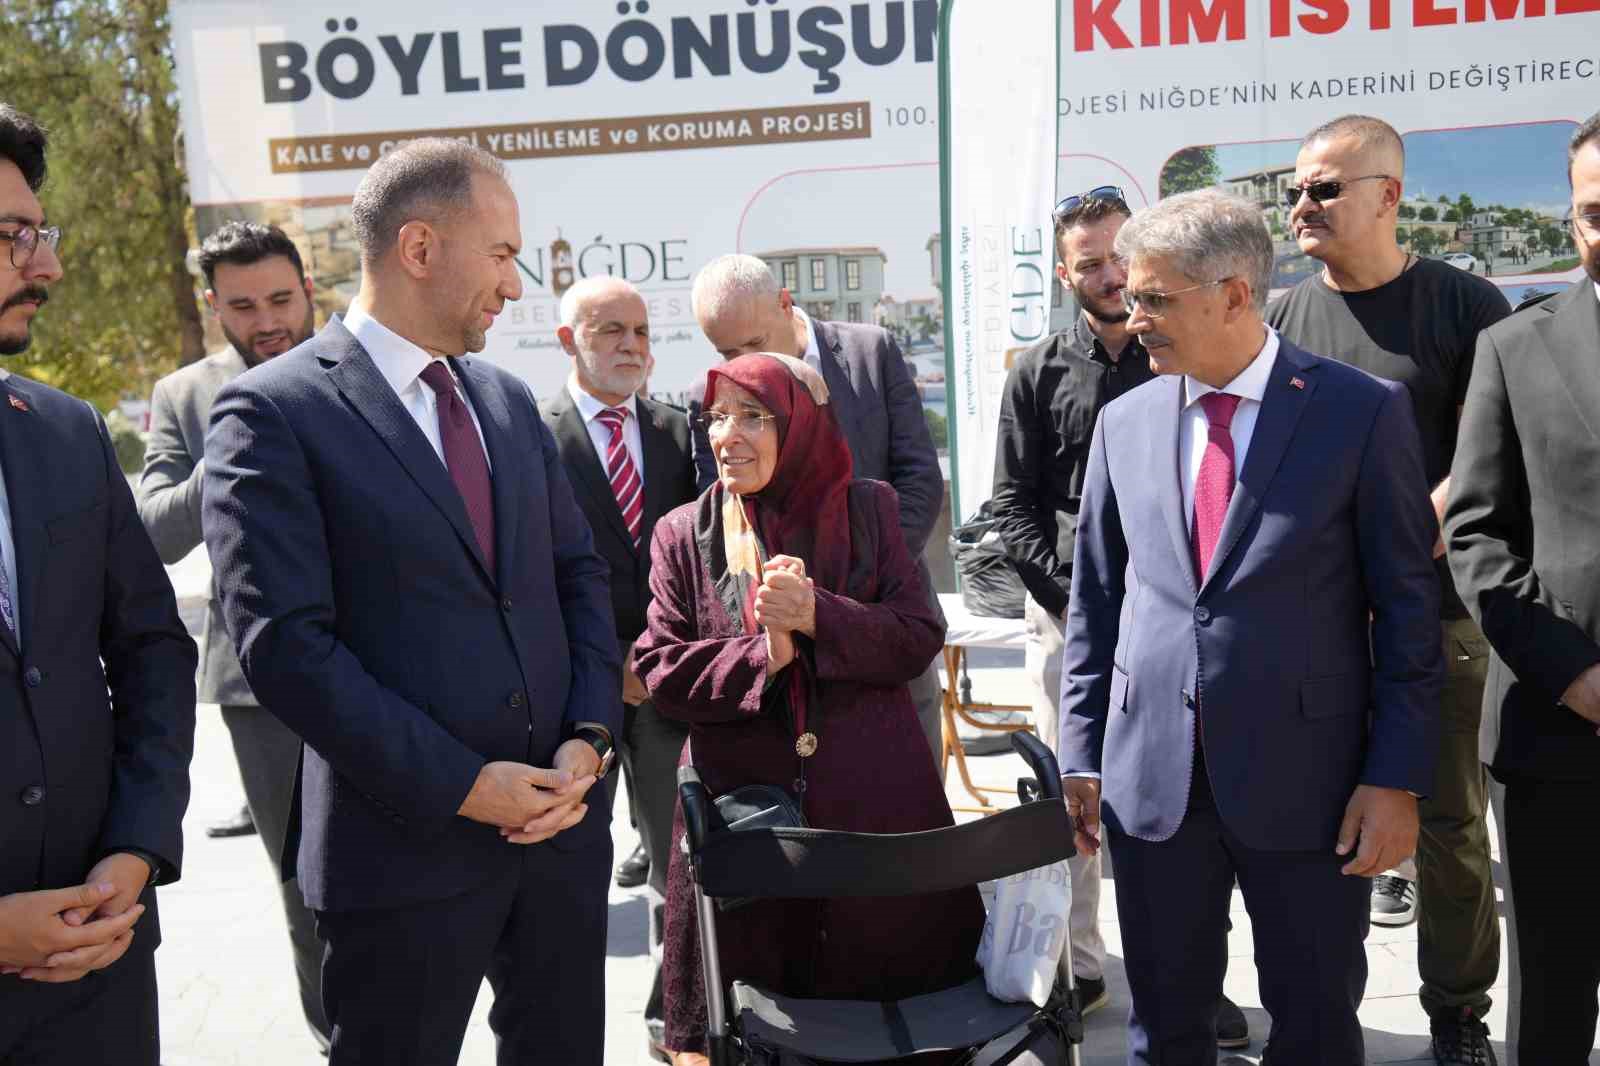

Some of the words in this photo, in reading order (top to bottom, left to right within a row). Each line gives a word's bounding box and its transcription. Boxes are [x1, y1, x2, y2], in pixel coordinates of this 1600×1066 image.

[258, 17, 525, 104] BÖYLE
[1059, 90, 1127, 116] OJESİ
[1290, 70, 1416, 101] KADERİNİ
[1429, 59, 1600, 92] DEĞİŞTİREC
[487, 128, 600, 152] YENİLEME
[609, 130, 639, 145] ve
[647, 118, 752, 143] KORUMA
[762, 107, 865, 132] PROJESİ
[885, 107, 935, 126] 100.
[276, 144, 333, 166] KALE
[341, 146, 371, 161] ve
